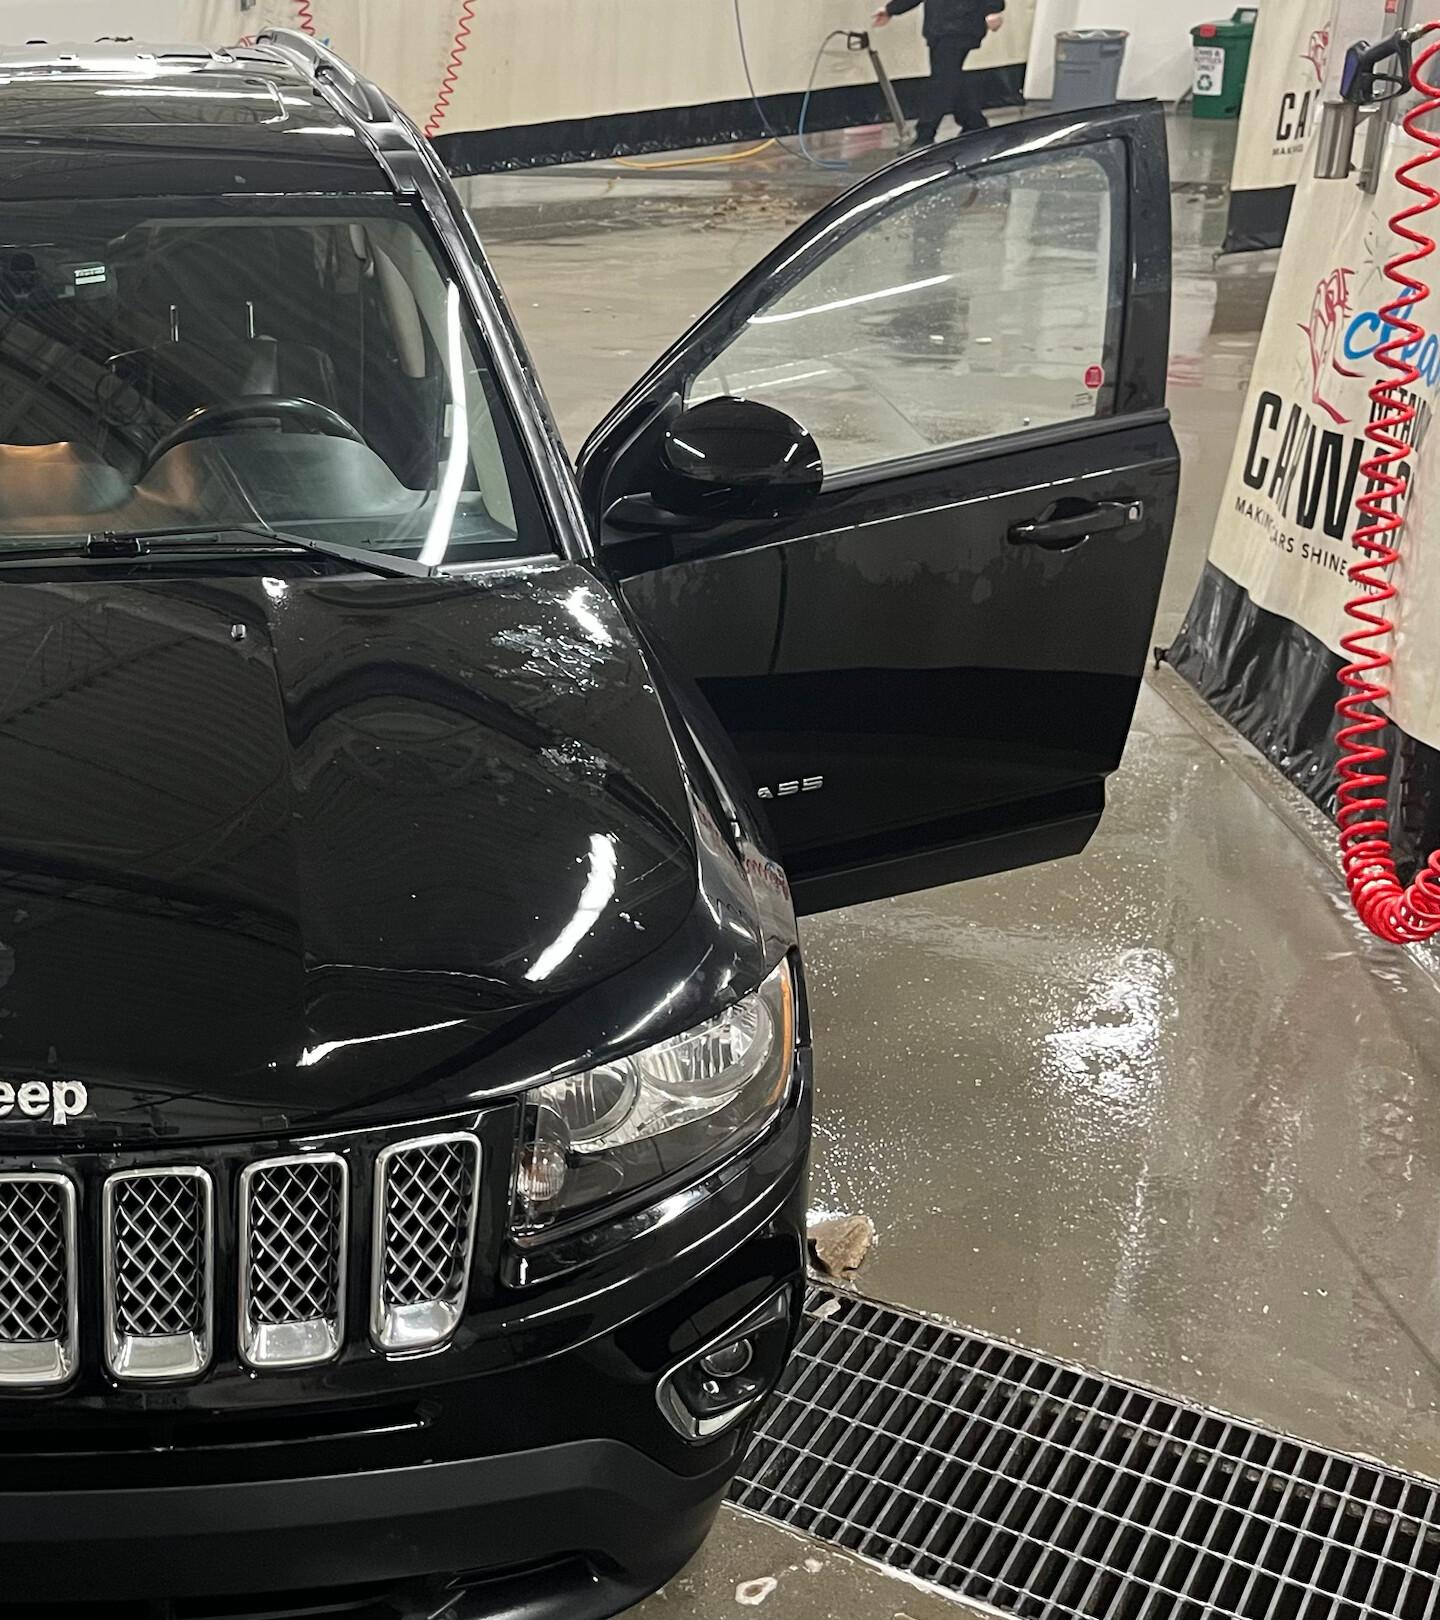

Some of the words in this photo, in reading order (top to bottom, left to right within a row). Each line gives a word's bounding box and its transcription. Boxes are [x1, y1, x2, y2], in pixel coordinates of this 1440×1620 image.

[1276, 90, 1320, 140] CA
[1244, 391, 1414, 573] CARWAS
[1235, 497, 1277, 532] MAKIN
[1301, 543, 1348, 577] SHINE
